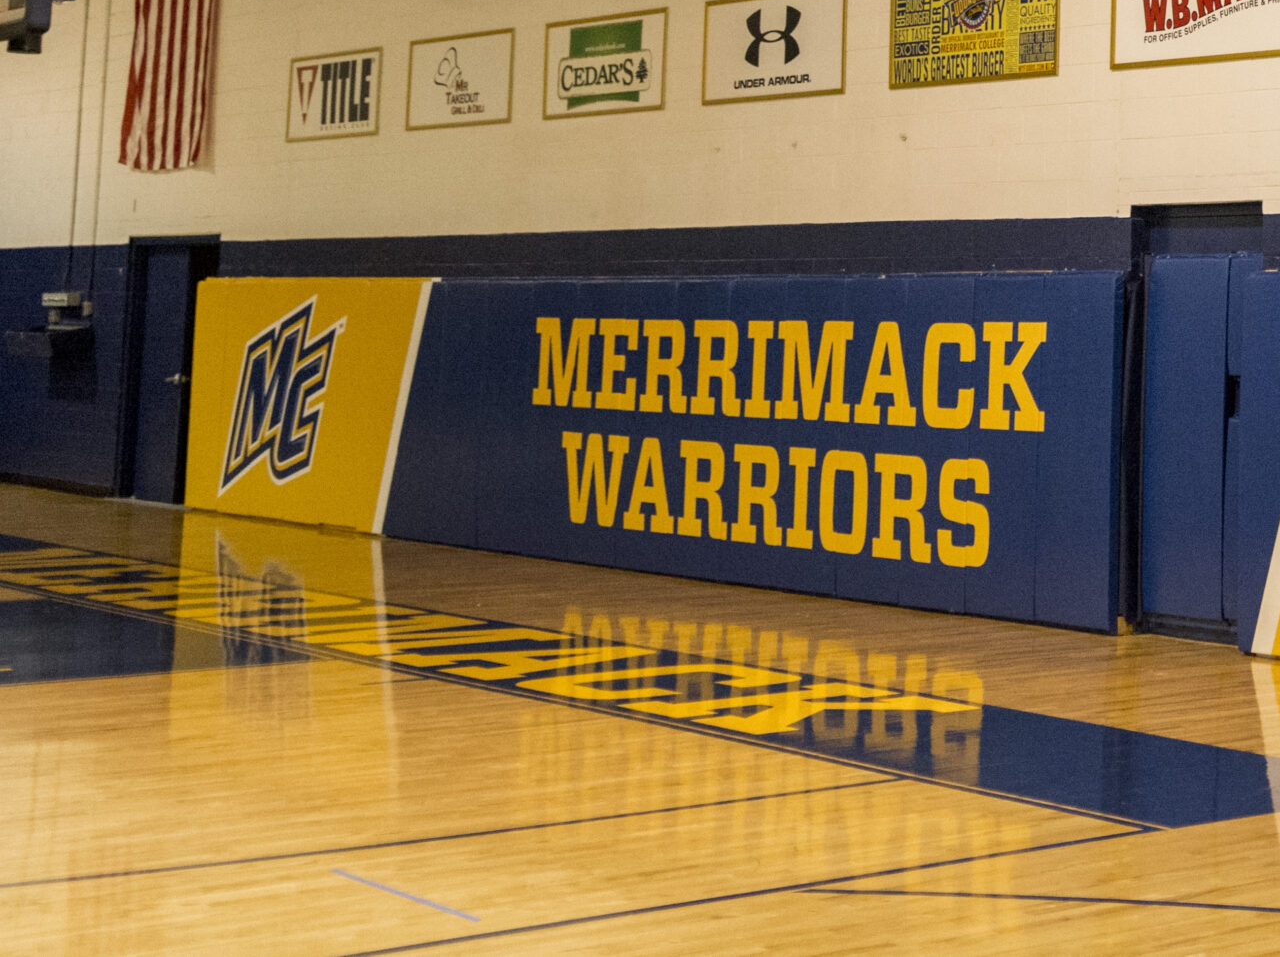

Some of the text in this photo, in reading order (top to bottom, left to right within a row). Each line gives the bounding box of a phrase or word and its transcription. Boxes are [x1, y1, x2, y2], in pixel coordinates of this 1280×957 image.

[1020, 3, 1056, 18] QUALITY
[931, 6, 942, 55] ORDER
[1144, 35, 1157, 44] FOR
[1159, 31, 1183, 42] OFFICE
[1184, 14, 1219, 36] SUPPLIES,
[895, 42, 929, 57] EXOTICS
[931, 54, 970, 81] GREATEST
[972, 50, 1005, 76] BURGER
[561, 58, 634, 92] CEDAR'S
[733, 78, 765, 90] UNDER
[321, 58, 373, 125] TITLE
[531, 316, 1048, 432] MERRIMACK
[561, 430, 991, 568] WARRIORS
